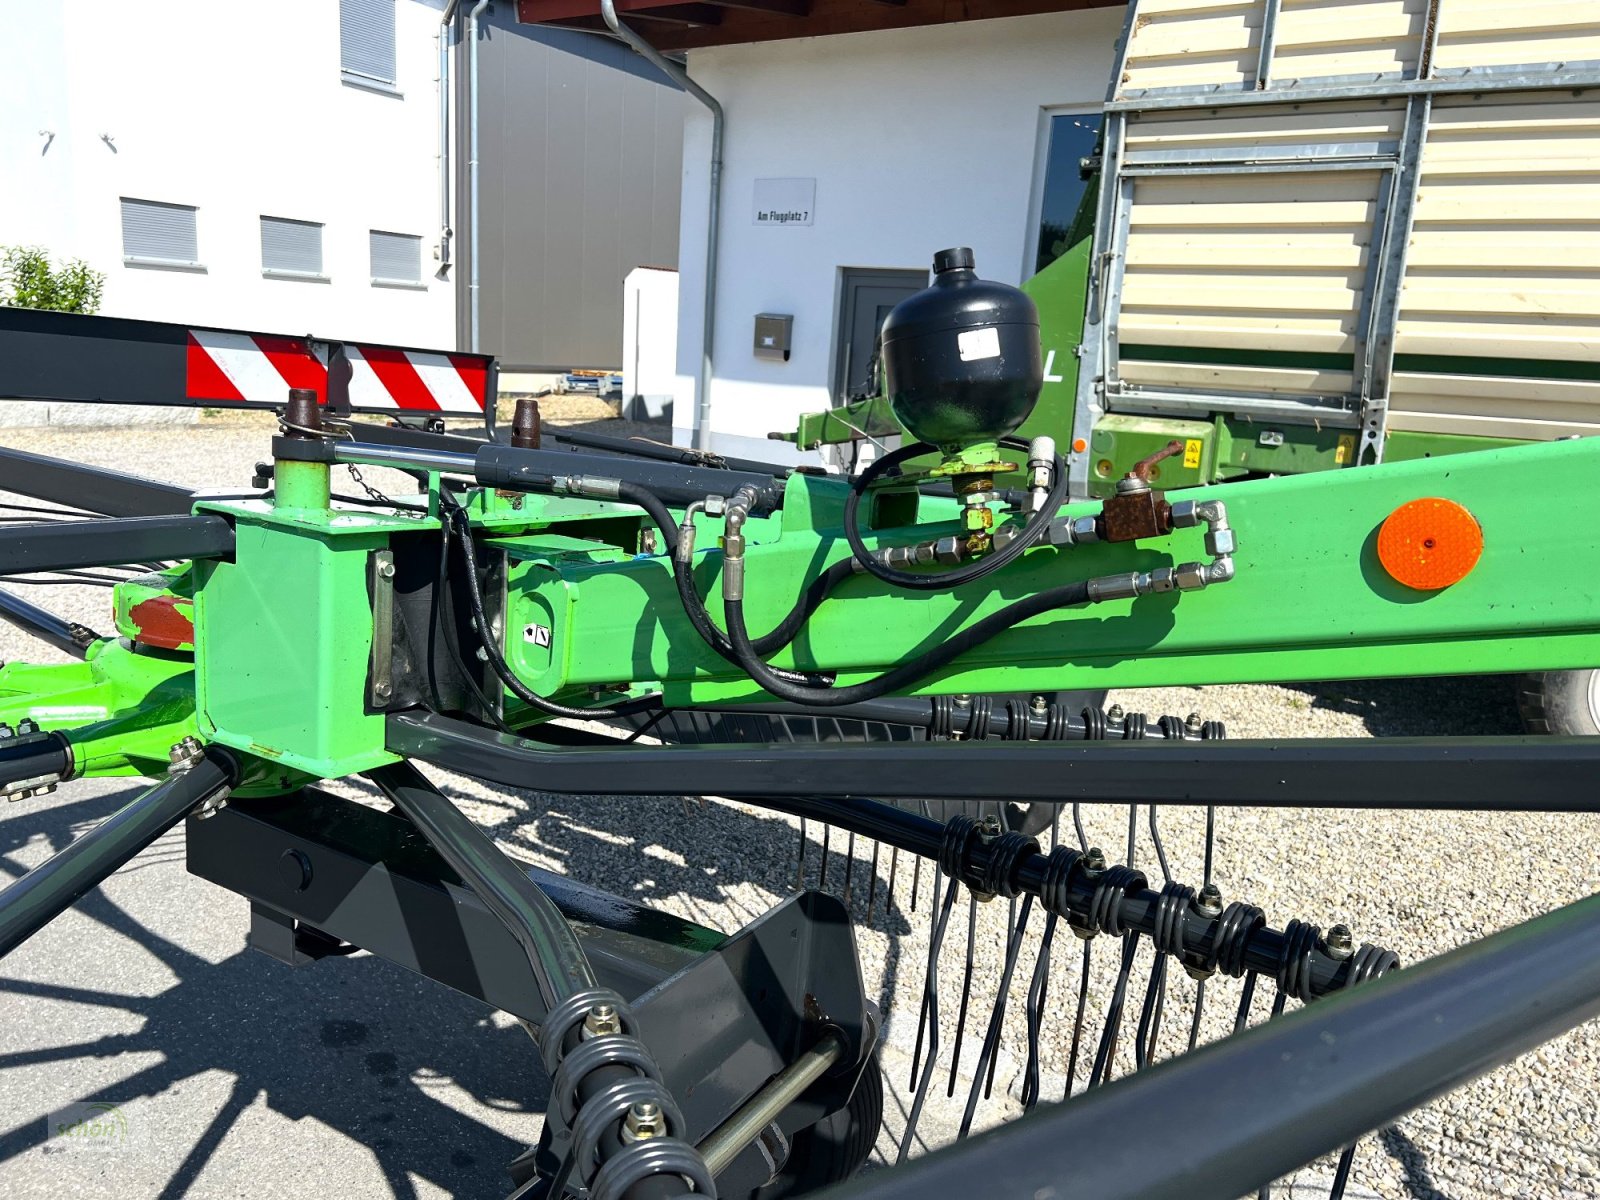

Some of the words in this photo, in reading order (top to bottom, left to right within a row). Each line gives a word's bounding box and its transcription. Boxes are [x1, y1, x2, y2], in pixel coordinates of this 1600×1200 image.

[758, 210, 769, 221] Am
[770, 210, 802, 223] Flugplatz
[803, 211, 809, 221] 7
